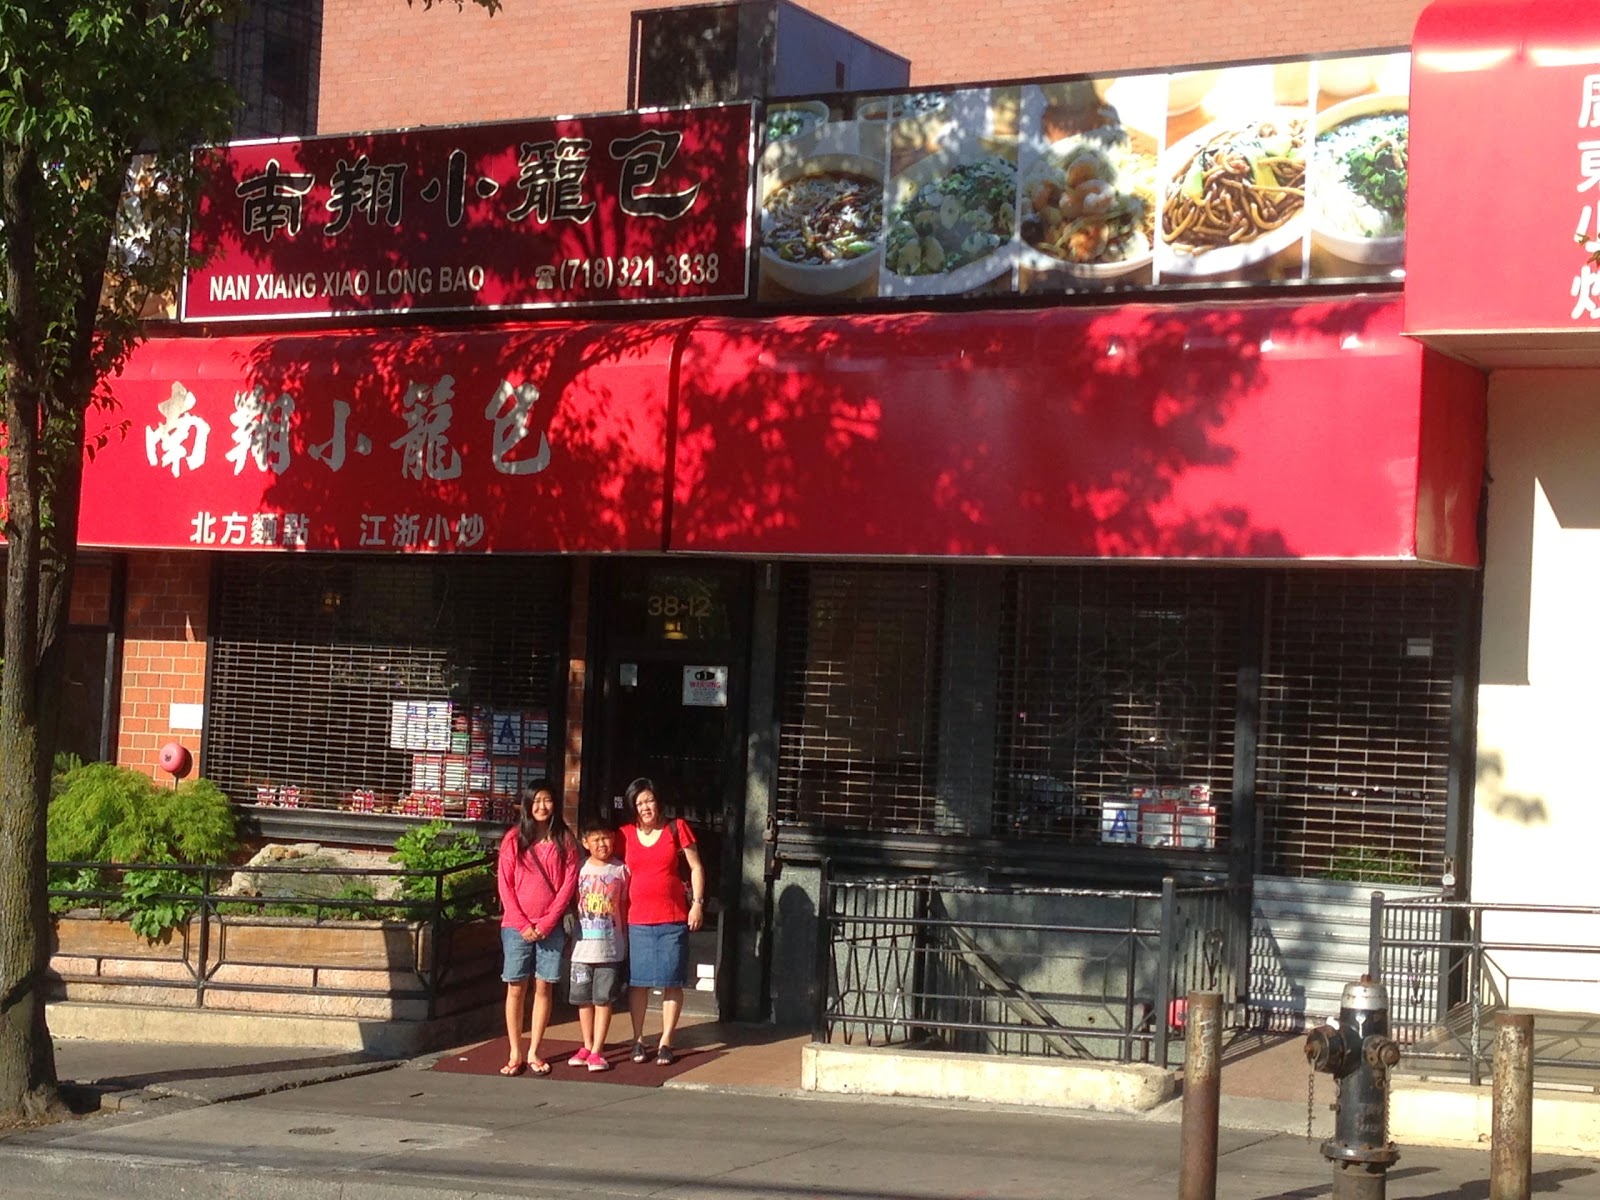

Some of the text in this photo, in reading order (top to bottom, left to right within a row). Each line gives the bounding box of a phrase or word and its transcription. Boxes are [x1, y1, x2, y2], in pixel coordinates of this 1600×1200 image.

[236, 130, 701, 242] 南翔小籠包
[209, 265, 485, 301] NAN XIANG XIAO LONG BAO
[145, 374, 551, 480] 南翔小籠包
[190, 511, 485, 547] 北方麵點 江浙小炒
[647, 596, 711, 617] 38-12
[497, 715, 516, 744] A
[1108, 809, 1132, 838] A
